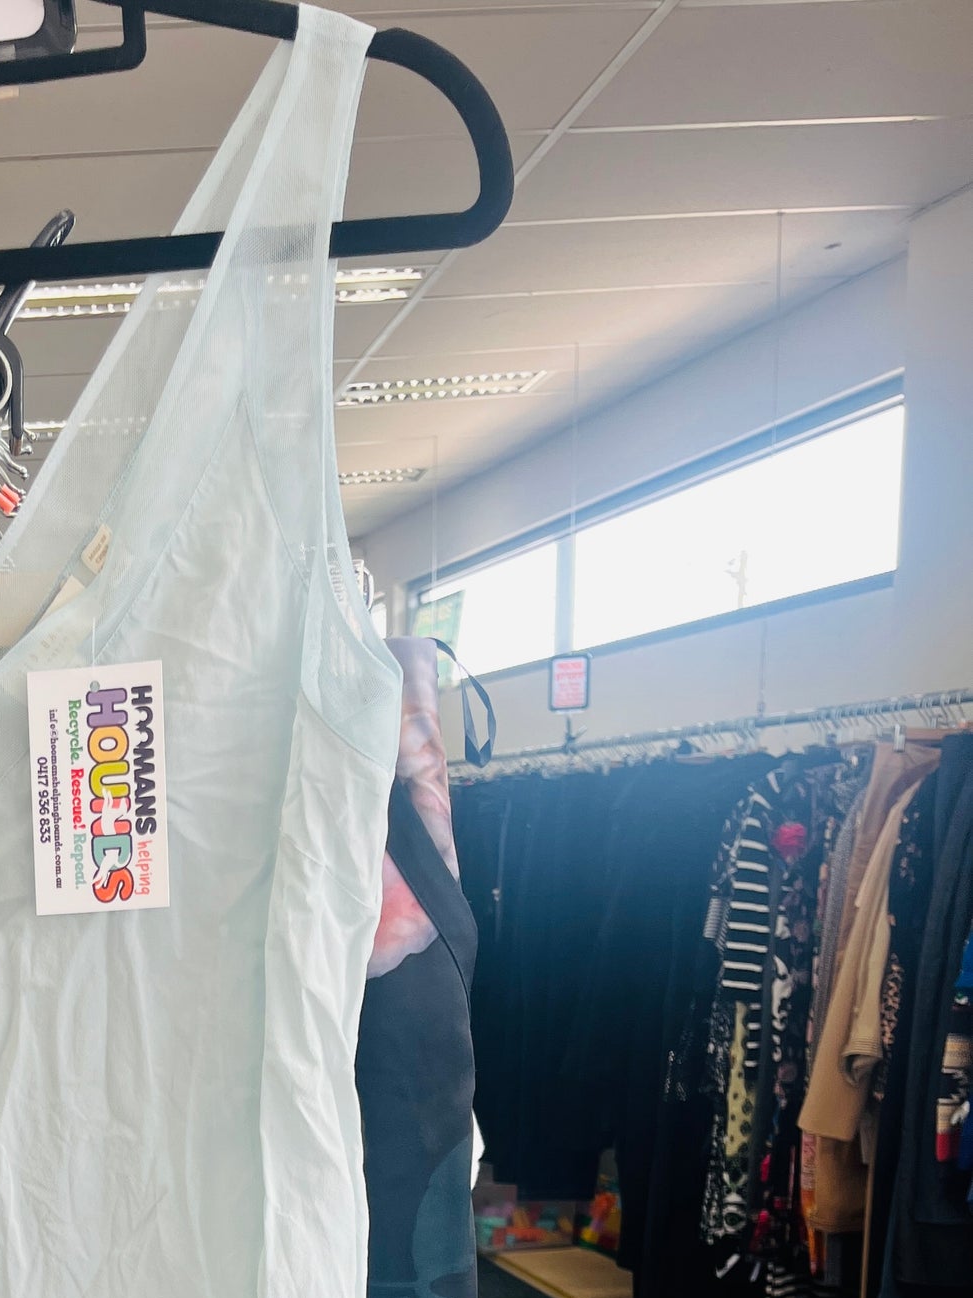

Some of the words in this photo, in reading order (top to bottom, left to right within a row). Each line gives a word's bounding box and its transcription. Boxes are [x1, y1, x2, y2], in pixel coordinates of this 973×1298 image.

[65, 699, 82, 765] Recycle.
[131, 685, 157, 836] HOOMANS
[37, 756, 49, 787] 0417
[48, 708, 63, 889] info@hoomanshelpinghounds.com.au
[70, 767, 87, 830] Rescue!
[85, 687, 134, 904] HOUNDS
[38, 790, 50, 816] 936
[40, 818, 52, 844] 833
[69, 832, 87, 890] Repeat.
[134, 840, 153, 896] helping
